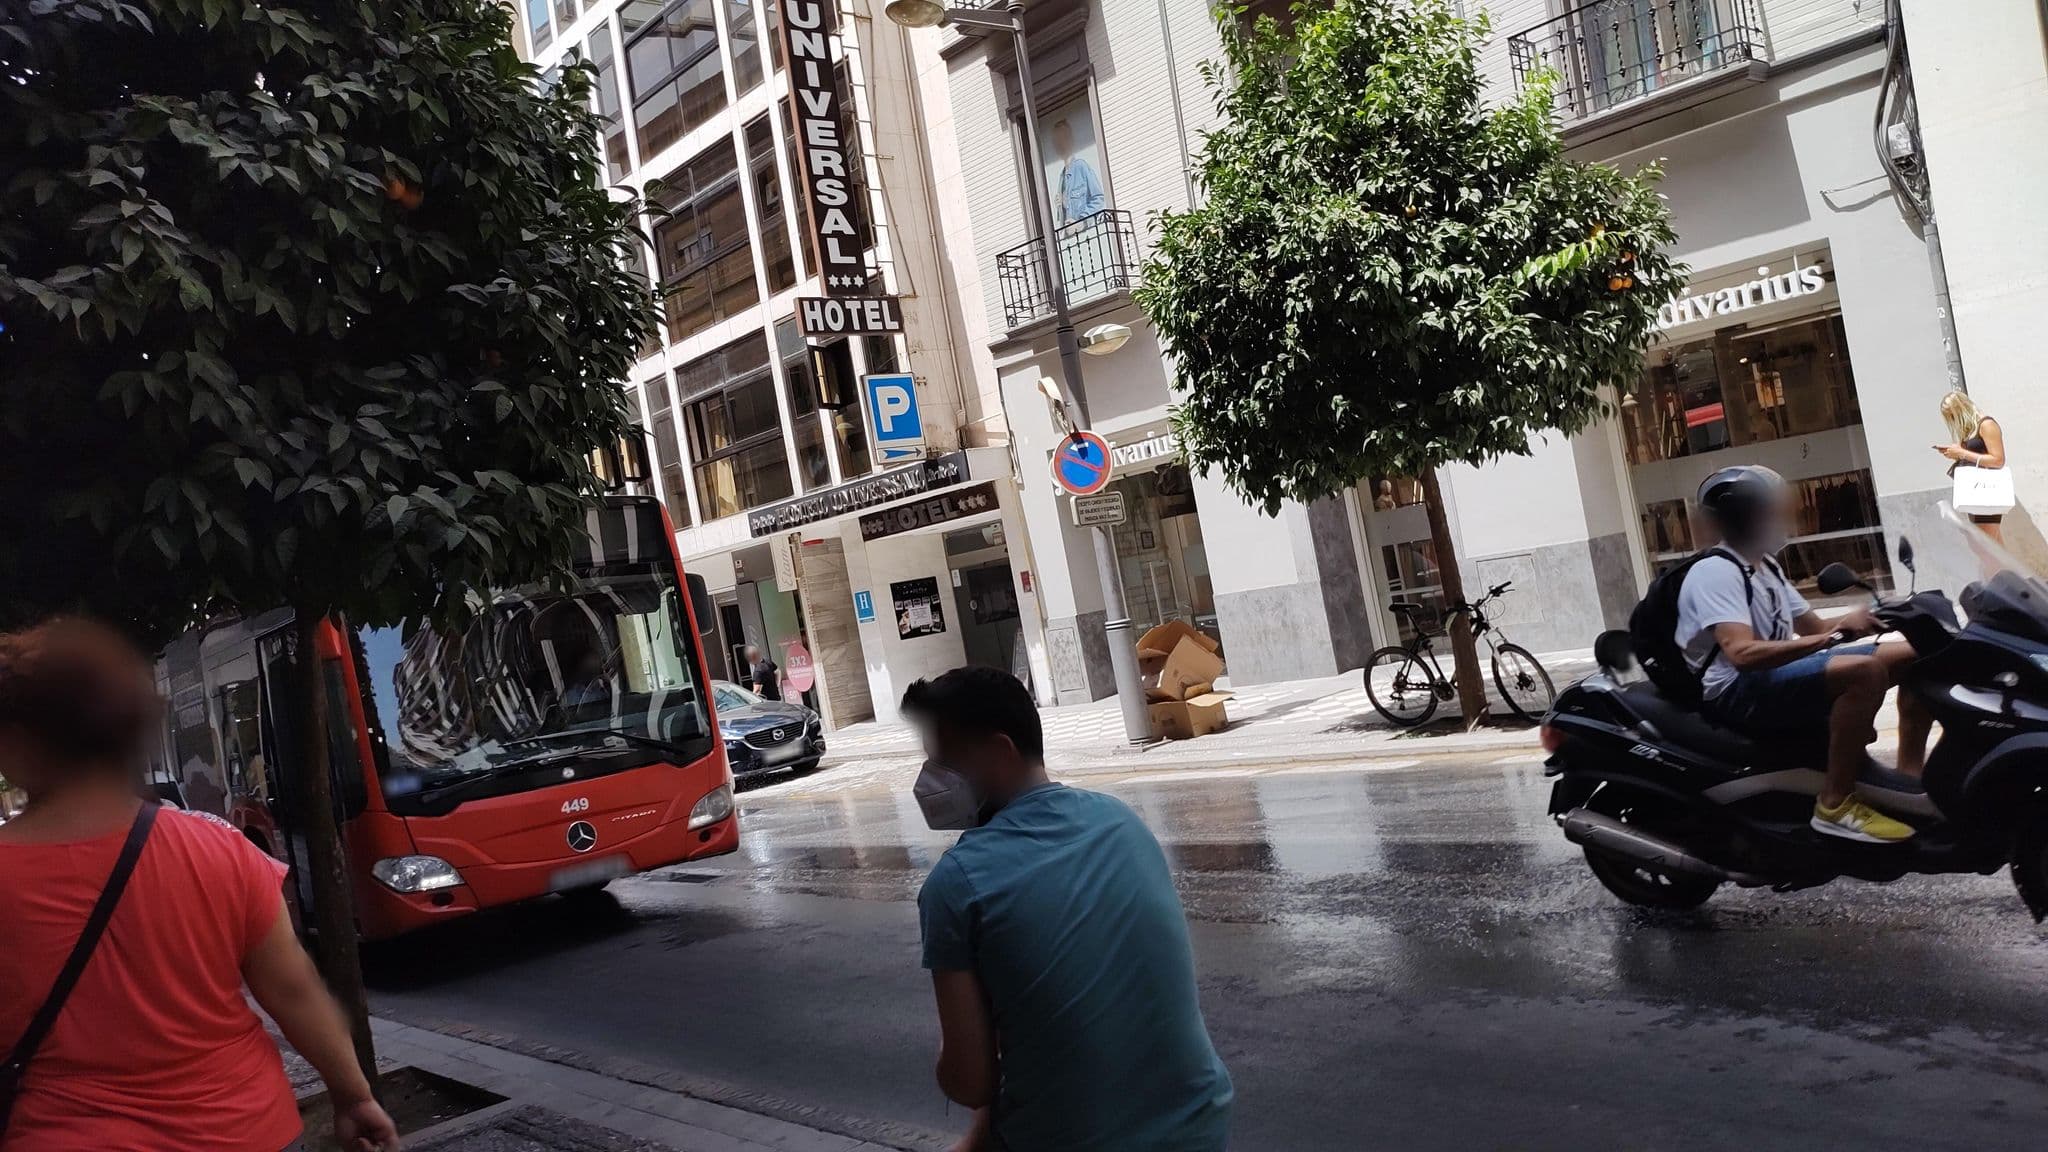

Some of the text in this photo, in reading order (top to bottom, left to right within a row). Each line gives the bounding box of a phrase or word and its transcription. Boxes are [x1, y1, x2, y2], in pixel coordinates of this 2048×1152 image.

[786, 0, 857, 264] UNIVERSAL
[1650, 250, 1826, 331] divarius
[802, 299, 899, 332] HOTEL
[875, 385, 911, 433] P
[774, 469, 926, 526] HOTEL UNIVERSAL
[882, 497, 959, 533] HOTEL
[859, 593, 869, 610] H
[561, 797, 590, 814] 449
